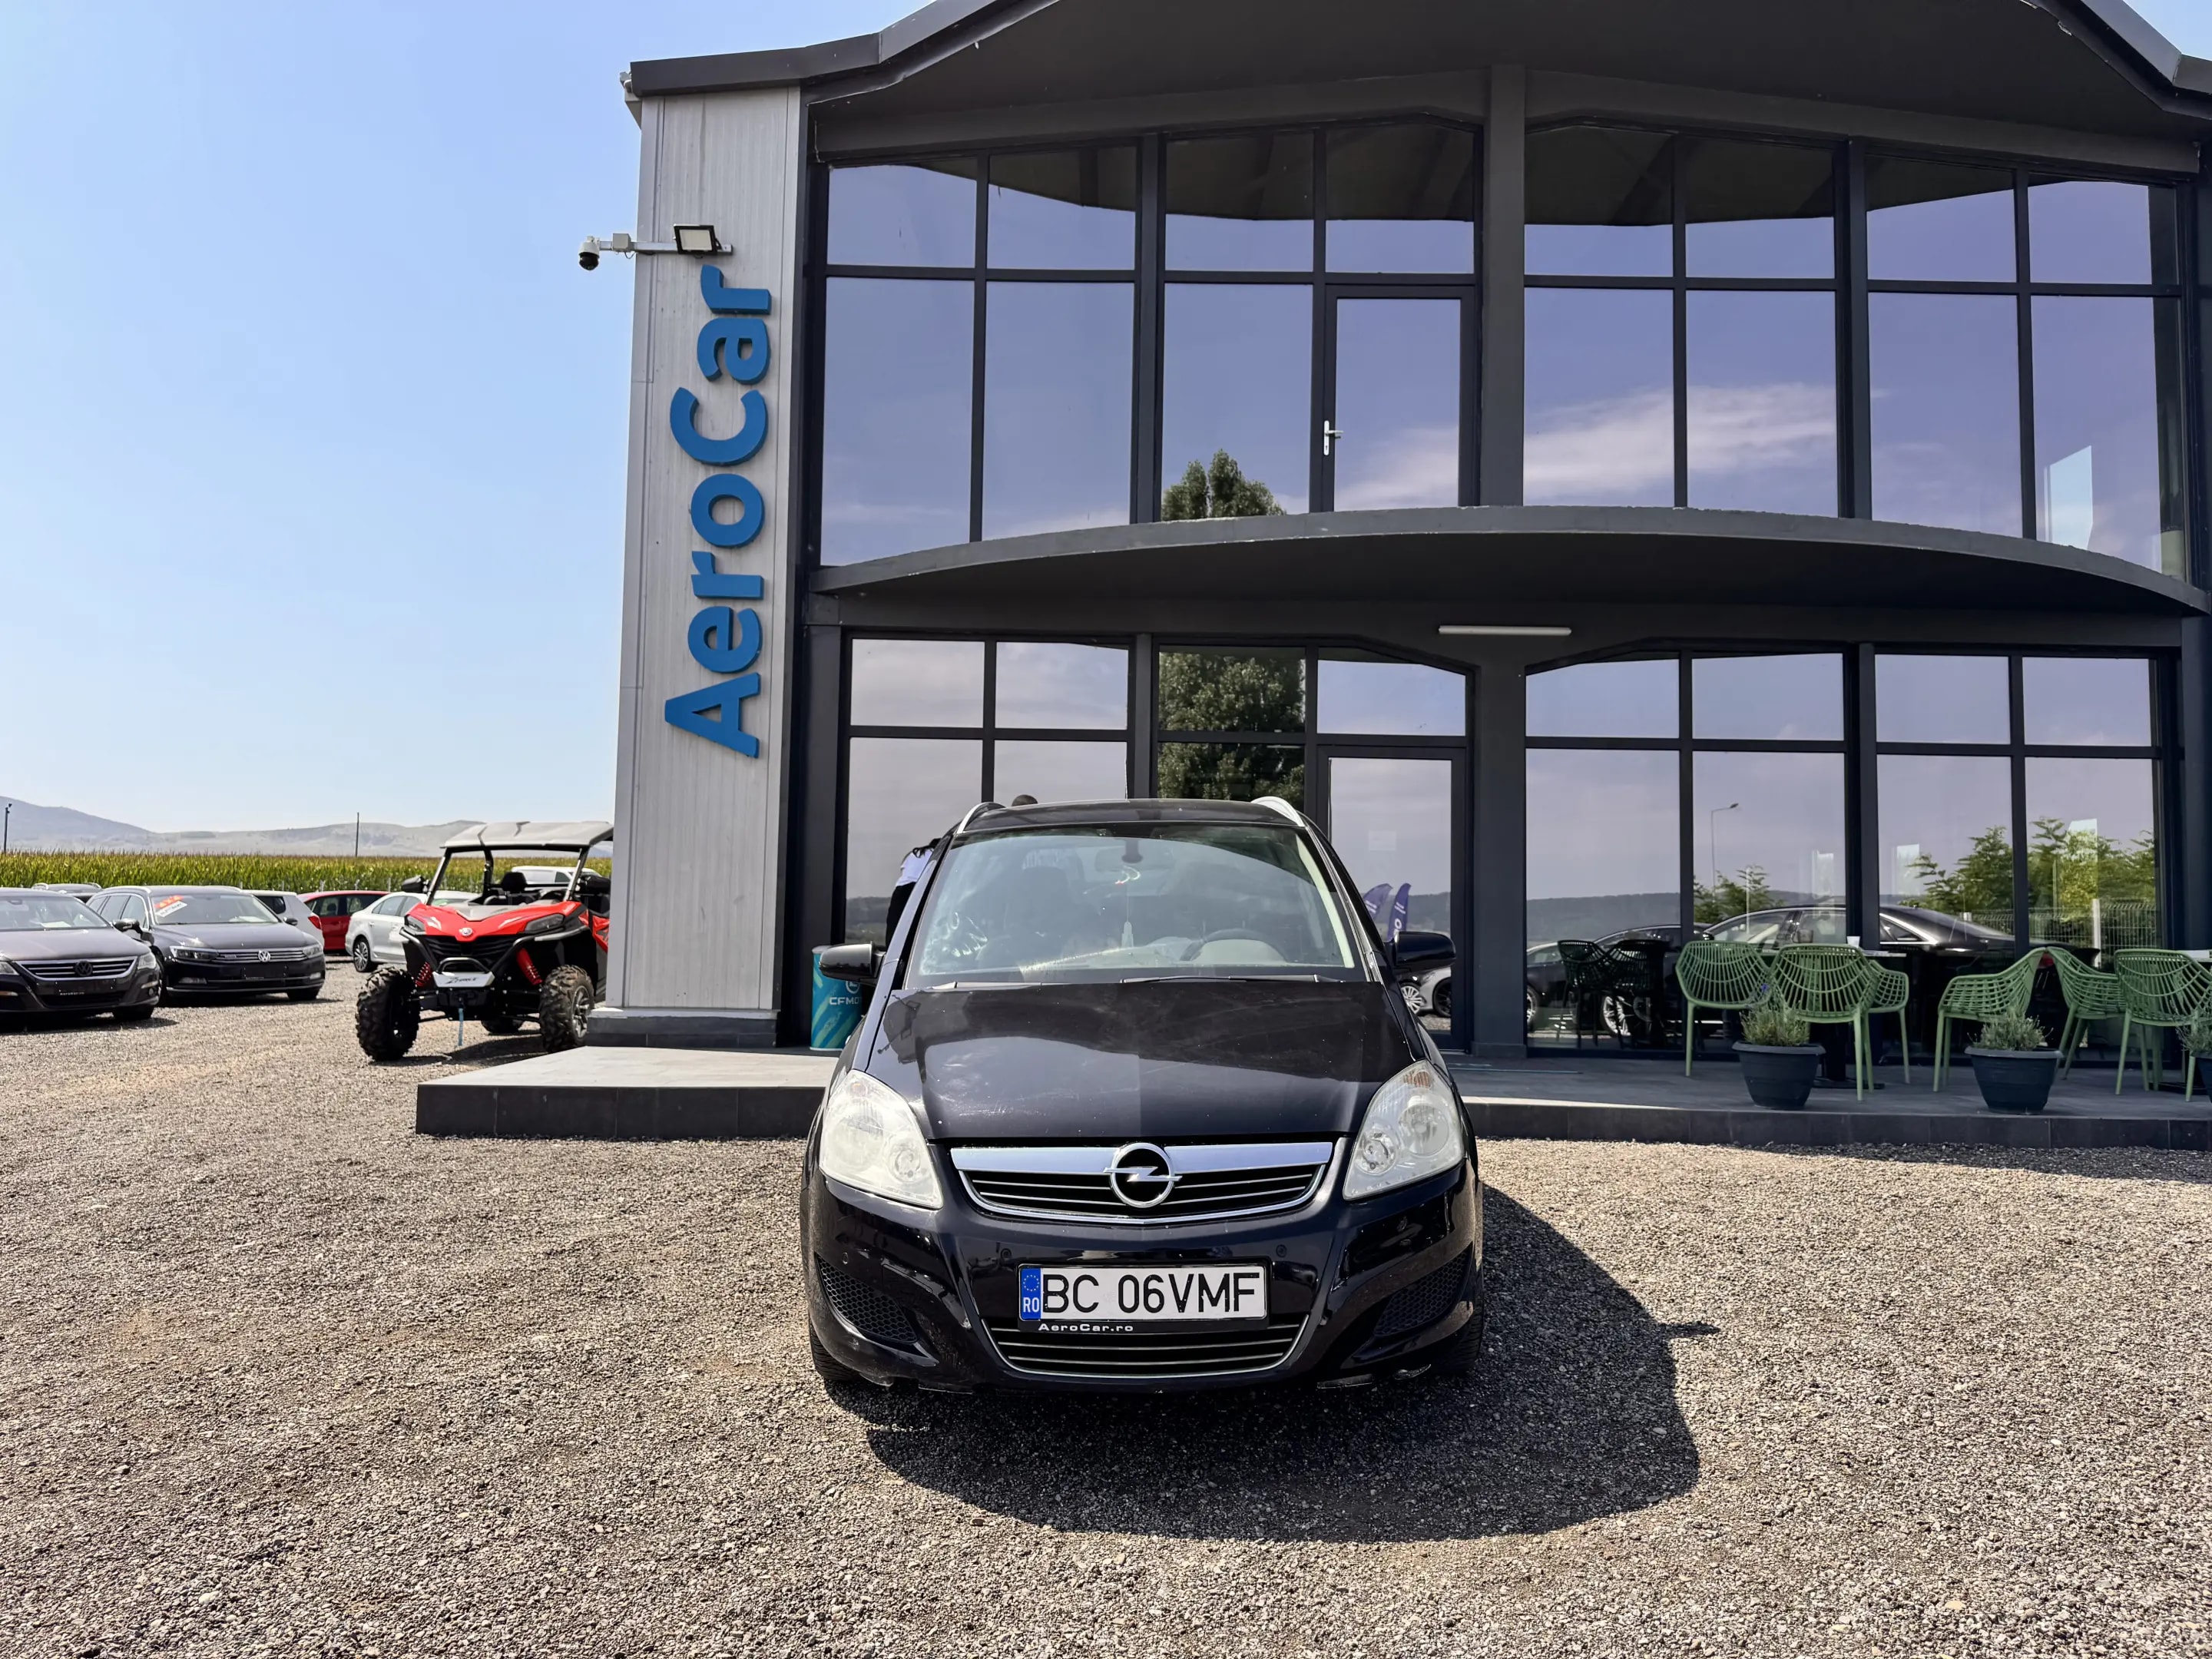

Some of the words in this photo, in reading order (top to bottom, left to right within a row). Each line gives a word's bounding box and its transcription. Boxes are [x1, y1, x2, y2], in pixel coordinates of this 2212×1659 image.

[665, 264, 771, 757] AeroCar
[1023, 1296, 1040, 1313] RO
[1043, 1273, 1099, 1313] BC
[1118, 1272, 1260, 1313] 06VMF
[1038, 1323, 1134, 1332] AeroCar.ro
